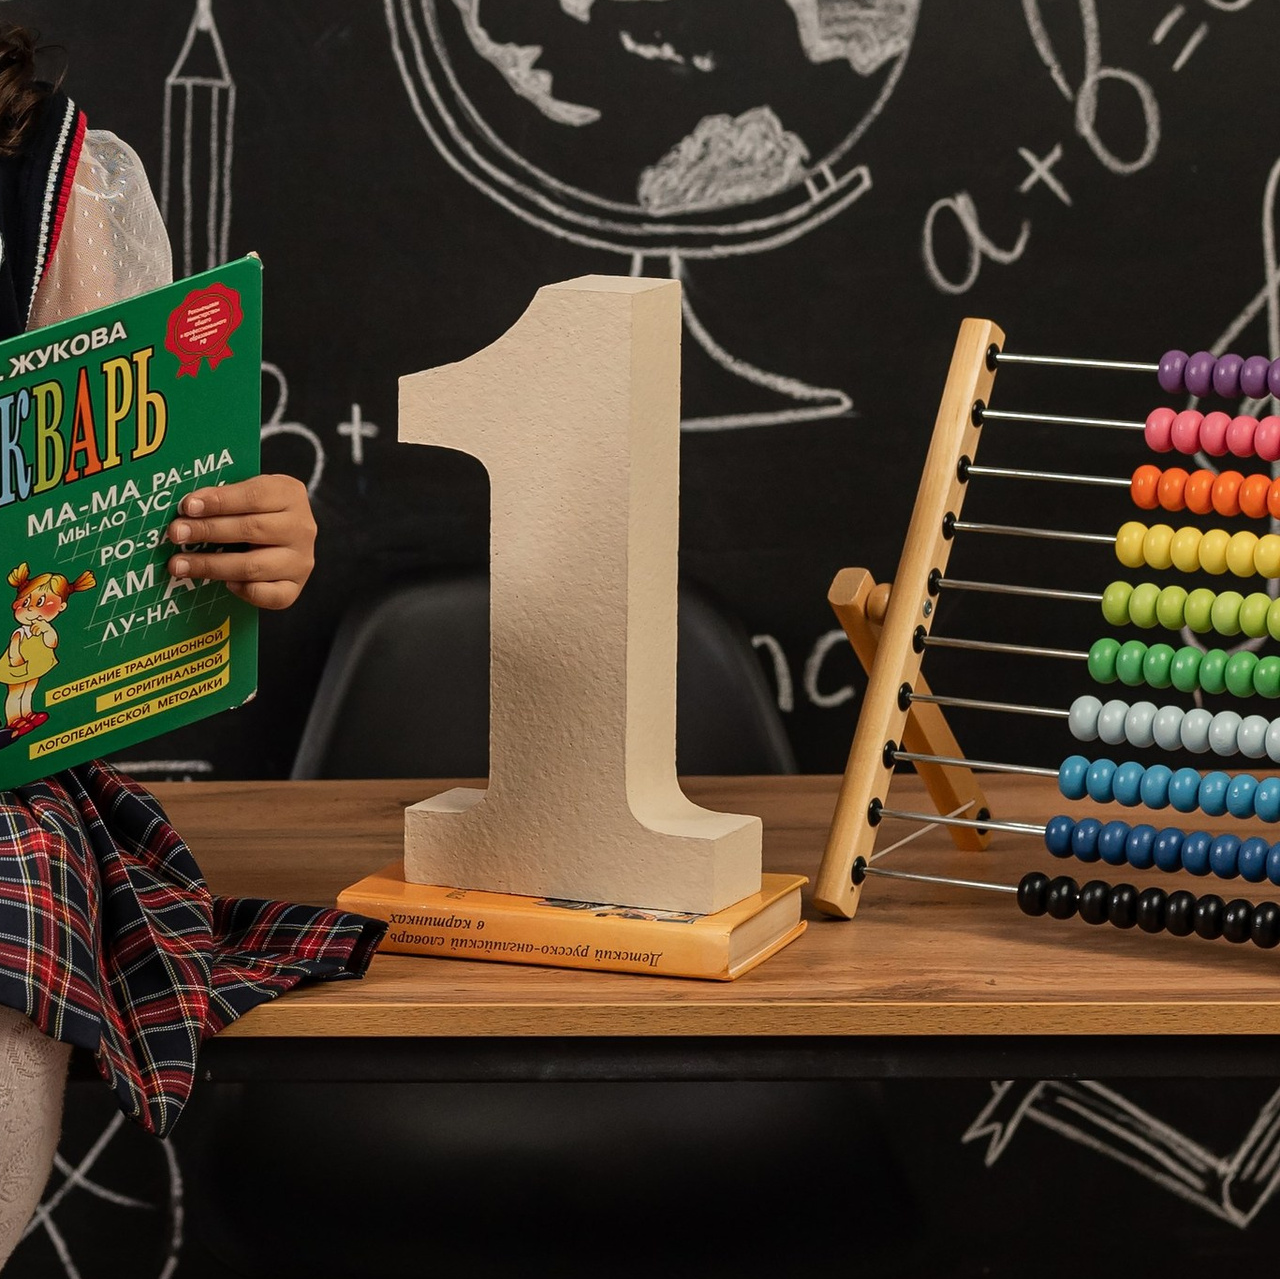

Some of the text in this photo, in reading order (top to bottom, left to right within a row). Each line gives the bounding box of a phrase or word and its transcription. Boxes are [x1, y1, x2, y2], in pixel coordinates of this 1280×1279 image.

[8, 320, 128, 379] ЖУКОВА
[152, 448, 234, 493] РА-МА
[27, 479, 141, 538] МА-МА
[58, 510, 127, 547] МЫ-ЛО
[100, 563, 156, 606] АМ
[102, 599, 181, 642] ЛУ-НА
[51, 628, 225, 702] СОЧЕТАНИЕ ТРАДИЦИОННОЙ
[113, 651, 224, 703] И ОРИГИНАЛЬНОЙ
[36, 676, 224, 755] ЛОГОПЕДИЧЕСКОЙ МЕТОДИКИ
[388, 913, 486, 931] в картинках
[389, 931, 664, 969] Детский русско-английский словарь
